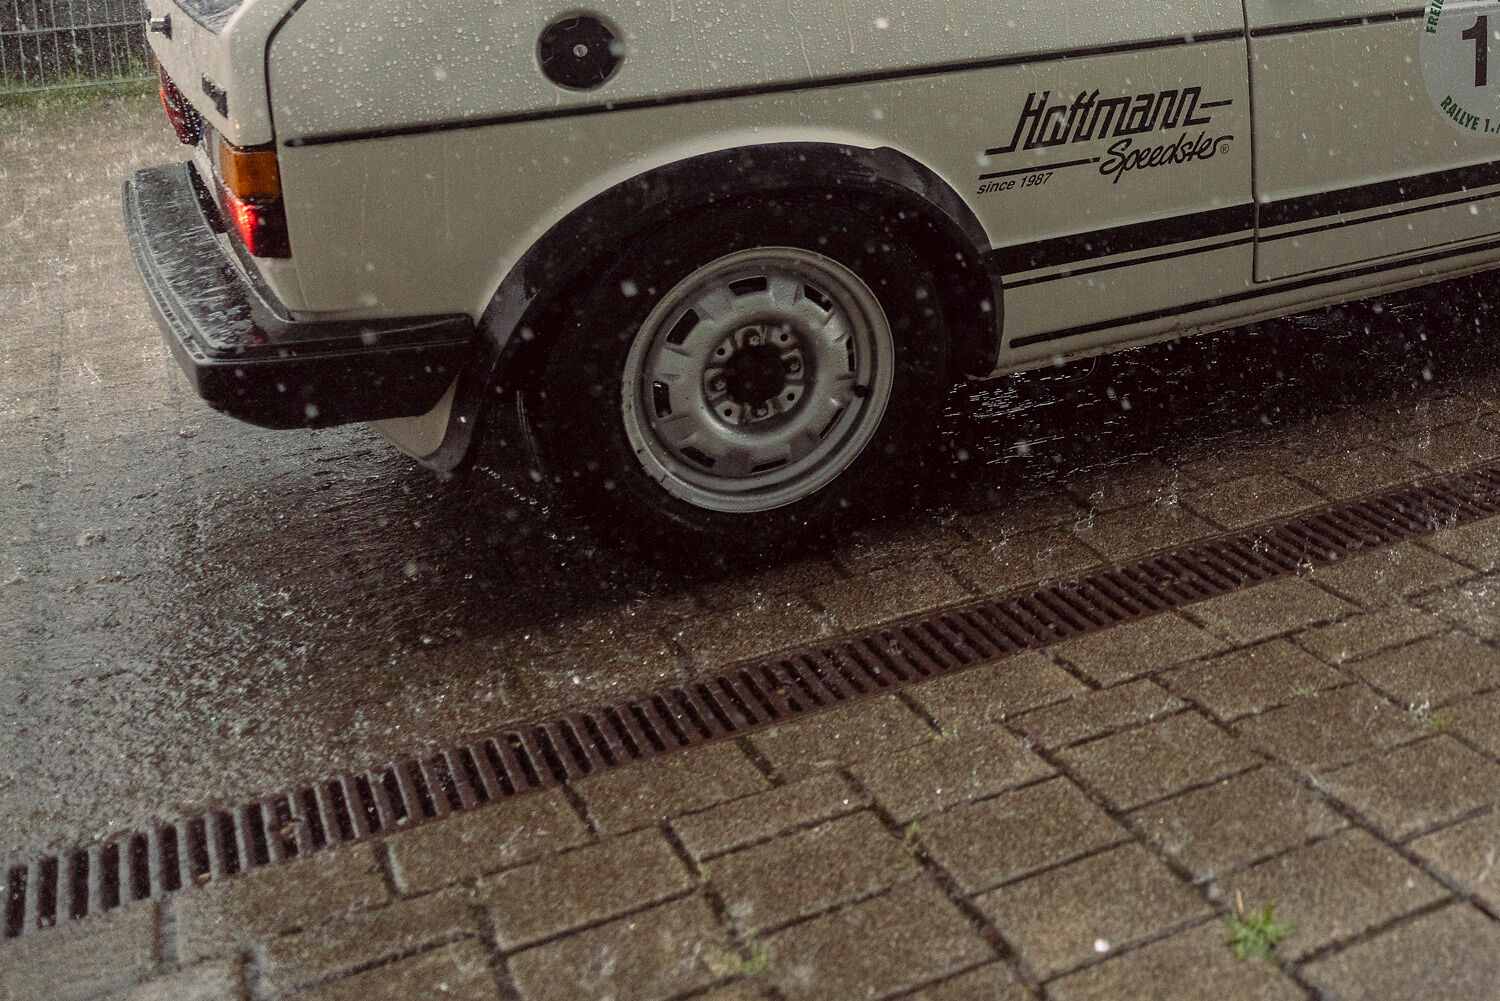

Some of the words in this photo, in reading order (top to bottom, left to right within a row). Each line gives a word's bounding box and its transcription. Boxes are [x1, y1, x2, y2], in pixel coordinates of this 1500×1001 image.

[984, 86, 1233, 156] Hoffmann
[1440, 94, 1481, 132] RALLYE
[1099, 131, 1234, 184] Speedster
[976, 178, 1016, 195] since
[1020, 171, 1054, 189] 1987
